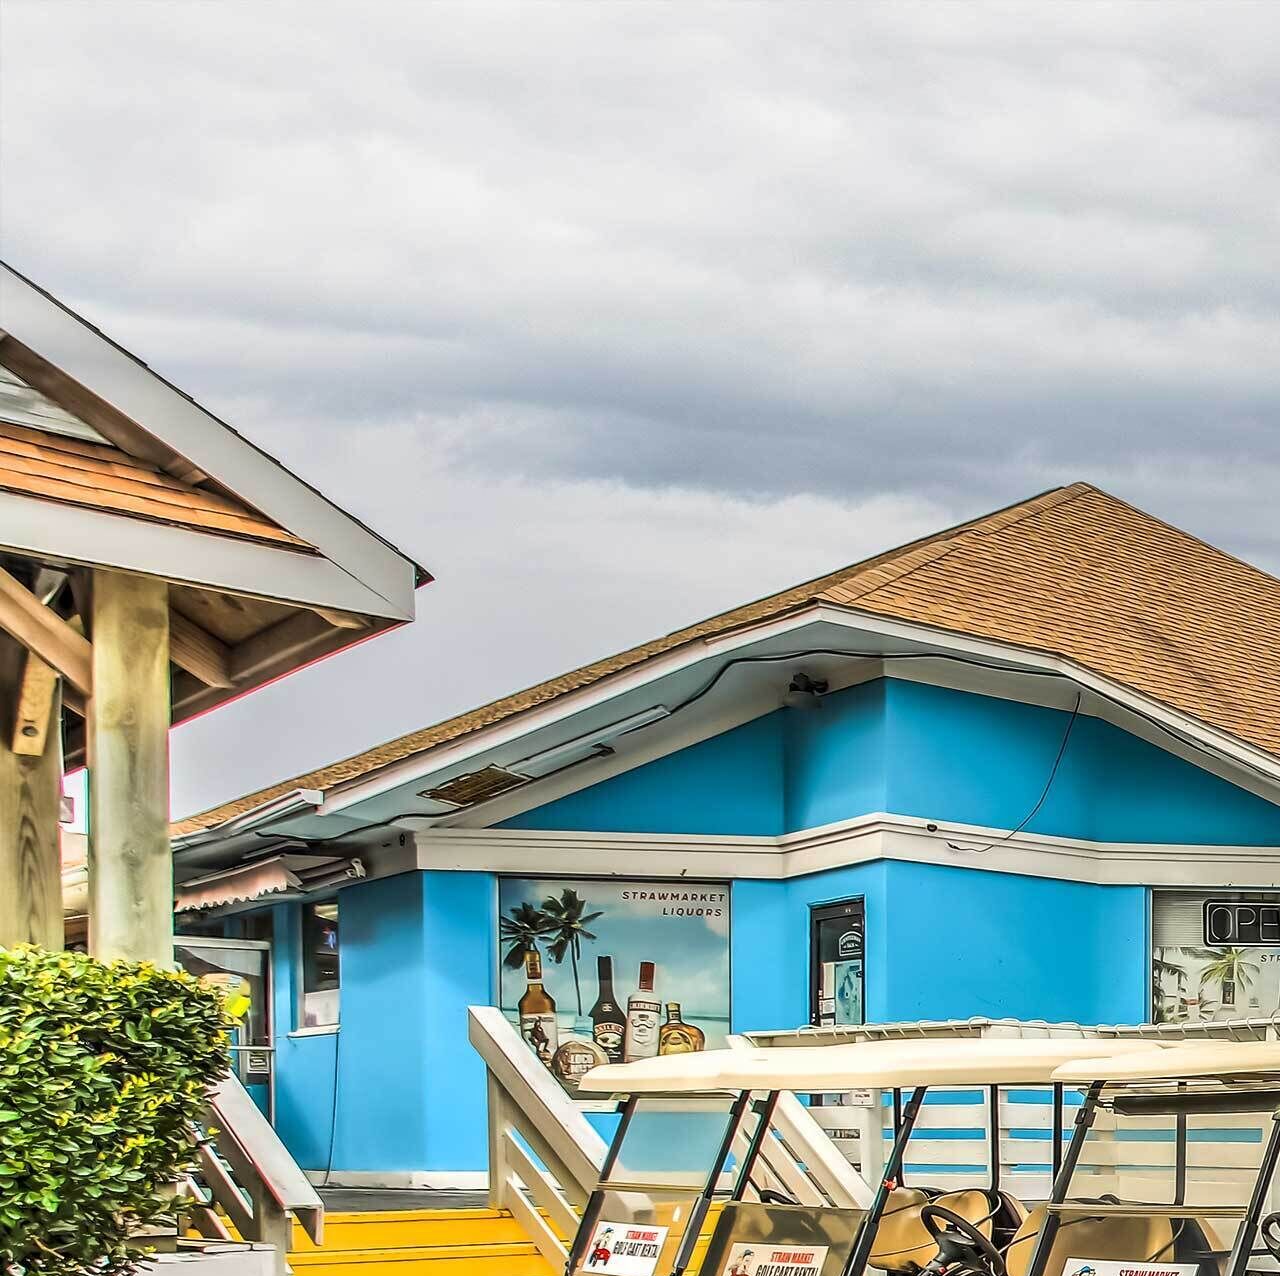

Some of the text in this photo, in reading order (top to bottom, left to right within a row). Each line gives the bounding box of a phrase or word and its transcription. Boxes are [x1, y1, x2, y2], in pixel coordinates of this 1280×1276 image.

[622, 891, 725, 902] STRAWMARKET
[662, 907, 722, 917] LIQUORS
[771, 1252, 792, 1263] STRAW
